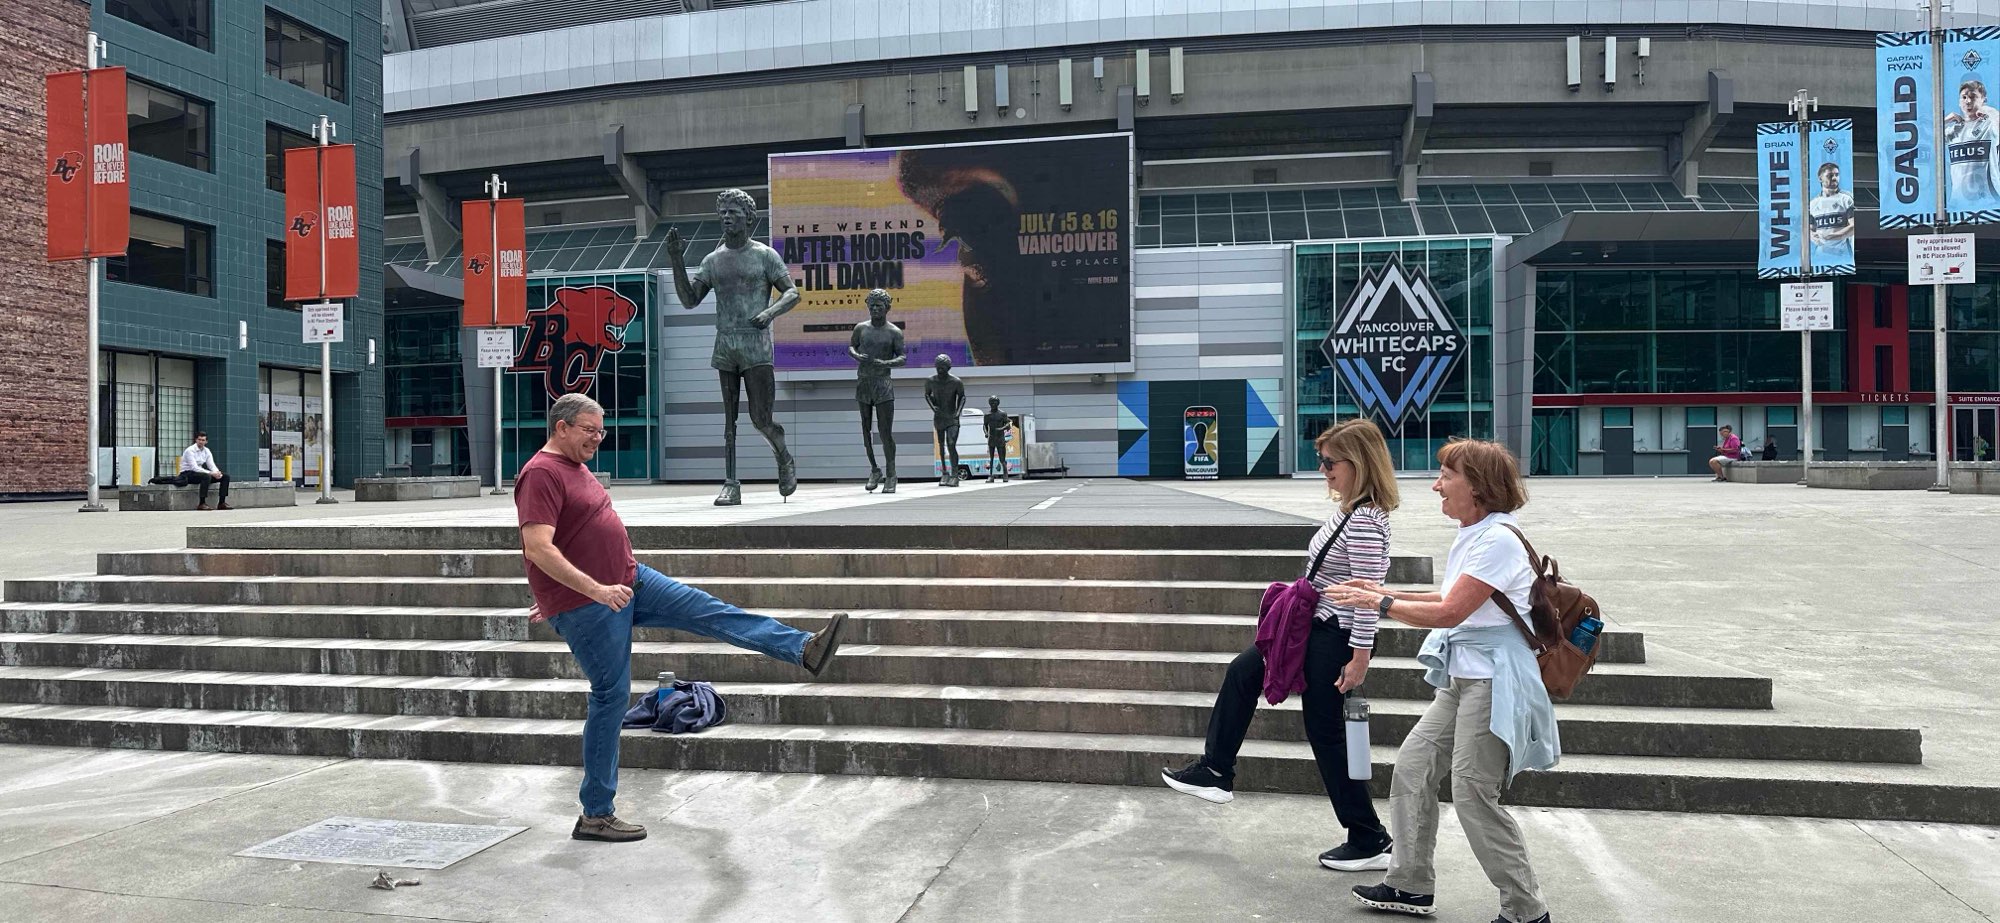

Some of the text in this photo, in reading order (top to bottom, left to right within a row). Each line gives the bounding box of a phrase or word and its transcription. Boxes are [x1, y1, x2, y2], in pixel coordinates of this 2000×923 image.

[1887, 62, 1922, 71] RYAN
[1894, 76, 1919, 204] GAULD
[94, 143, 124, 163] ROAR
[94, 170, 125, 185] BEFORE
[328, 205, 353, 222] ROAR
[1769, 151, 1790, 260] WHITE
[783, 220, 925, 233] THE WEEKND
[1019, 209, 1118, 234] JULY 15 & 16
[328, 228, 355, 239] BEFORE
[783, 231, 925, 264] AFTER HOURS
[1018, 231, 1118, 255] VANCOUVER
[500, 250, 523, 263] ROAR
[1076, 257, 1119, 266] PLACE
[501, 268, 524, 278] BEFORE
[837, 261, 904, 290] DAWN
[1355, 322, 1434, 334] VANCOUVER
[1330, 335, 1457, 354] WHITECAPS
[504, 310, 604, 402] BC
[1381, 356, 1406, 372] FC
[1861, 394, 1909, 402] TICKETS
